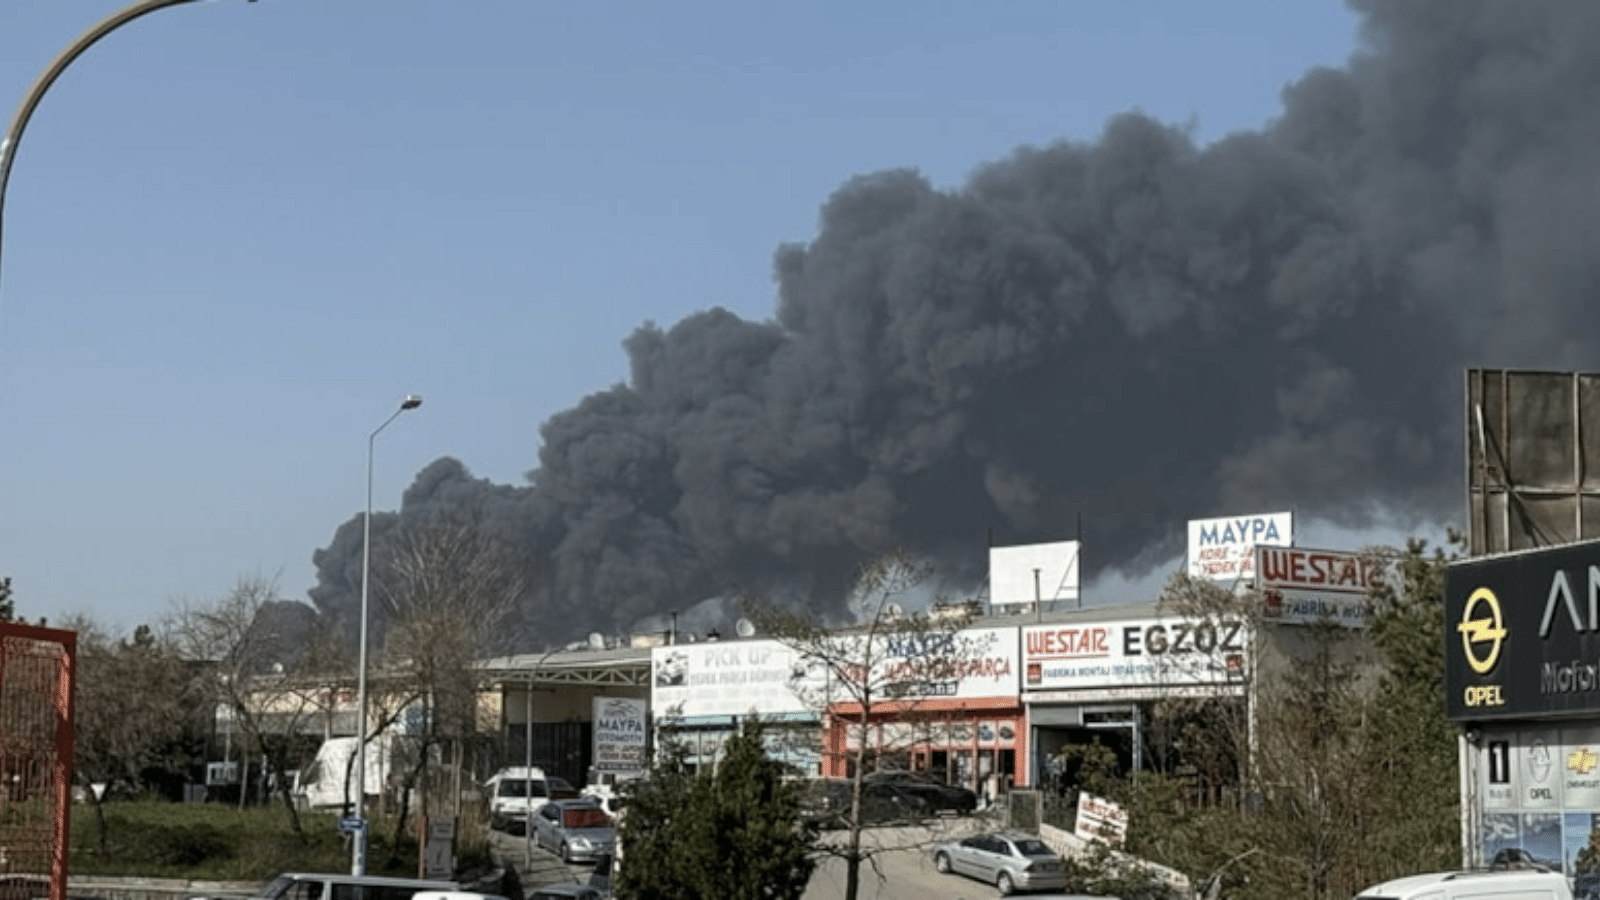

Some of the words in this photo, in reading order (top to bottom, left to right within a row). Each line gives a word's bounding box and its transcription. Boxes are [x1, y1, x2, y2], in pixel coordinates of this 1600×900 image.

[1199, 518, 1280, 546] MAYPA
[1026, 627, 1109, 656] WESTAR
[1122, 620, 1244, 656] EGZOZ
[1464, 685, 1505, 707] OPEL
[598, 718, 643, 732] MAYPA
[1529, 788, 1552, 800] OPEL
